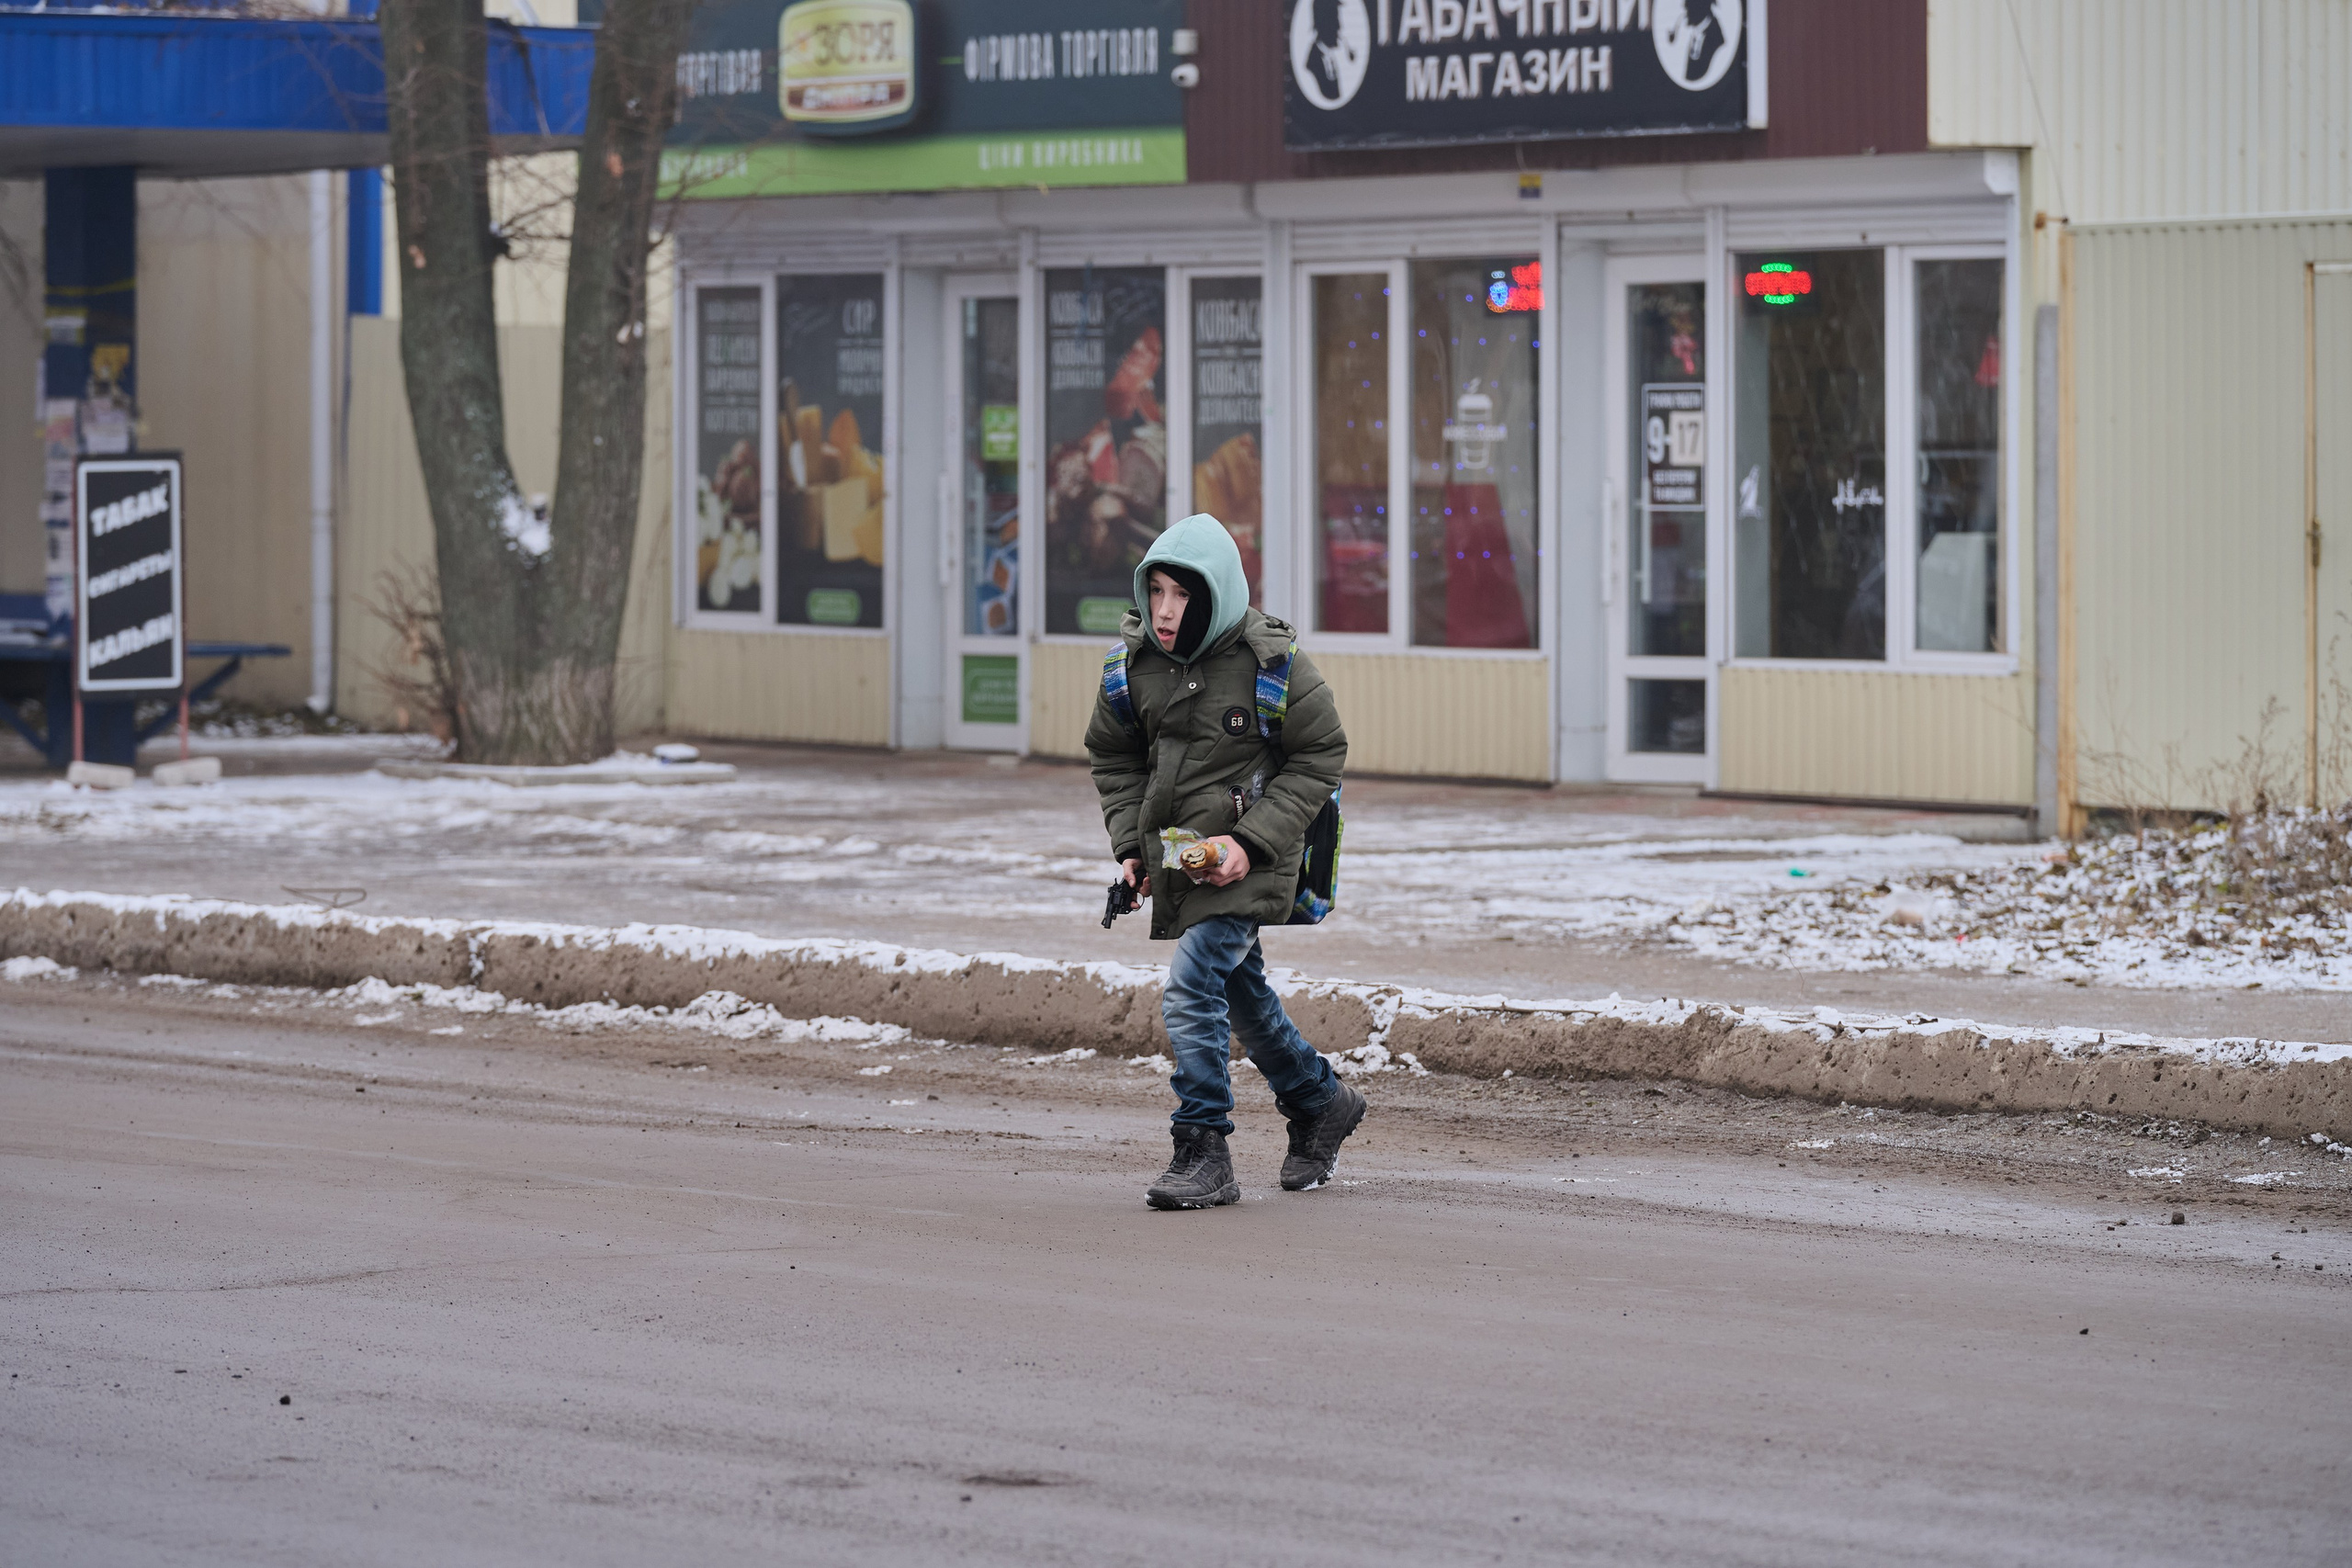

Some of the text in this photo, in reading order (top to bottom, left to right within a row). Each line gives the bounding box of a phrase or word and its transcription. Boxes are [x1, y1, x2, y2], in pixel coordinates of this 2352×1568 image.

[816, 20, 895, 65] ЗОРЯ
[965, 27, 1159, 81] ФІРМОВА ТОРГІВЛЯ
[1405, 46, 1612, 102] МАГАЗИН
[90, 483, 169, 537] ТАБАК
[88, 549, 173, 599] СИГАРЕТЫ
[88, 613, 173, 669] КАЛЬЯН
[1231, 716, 1243, 727] 68
